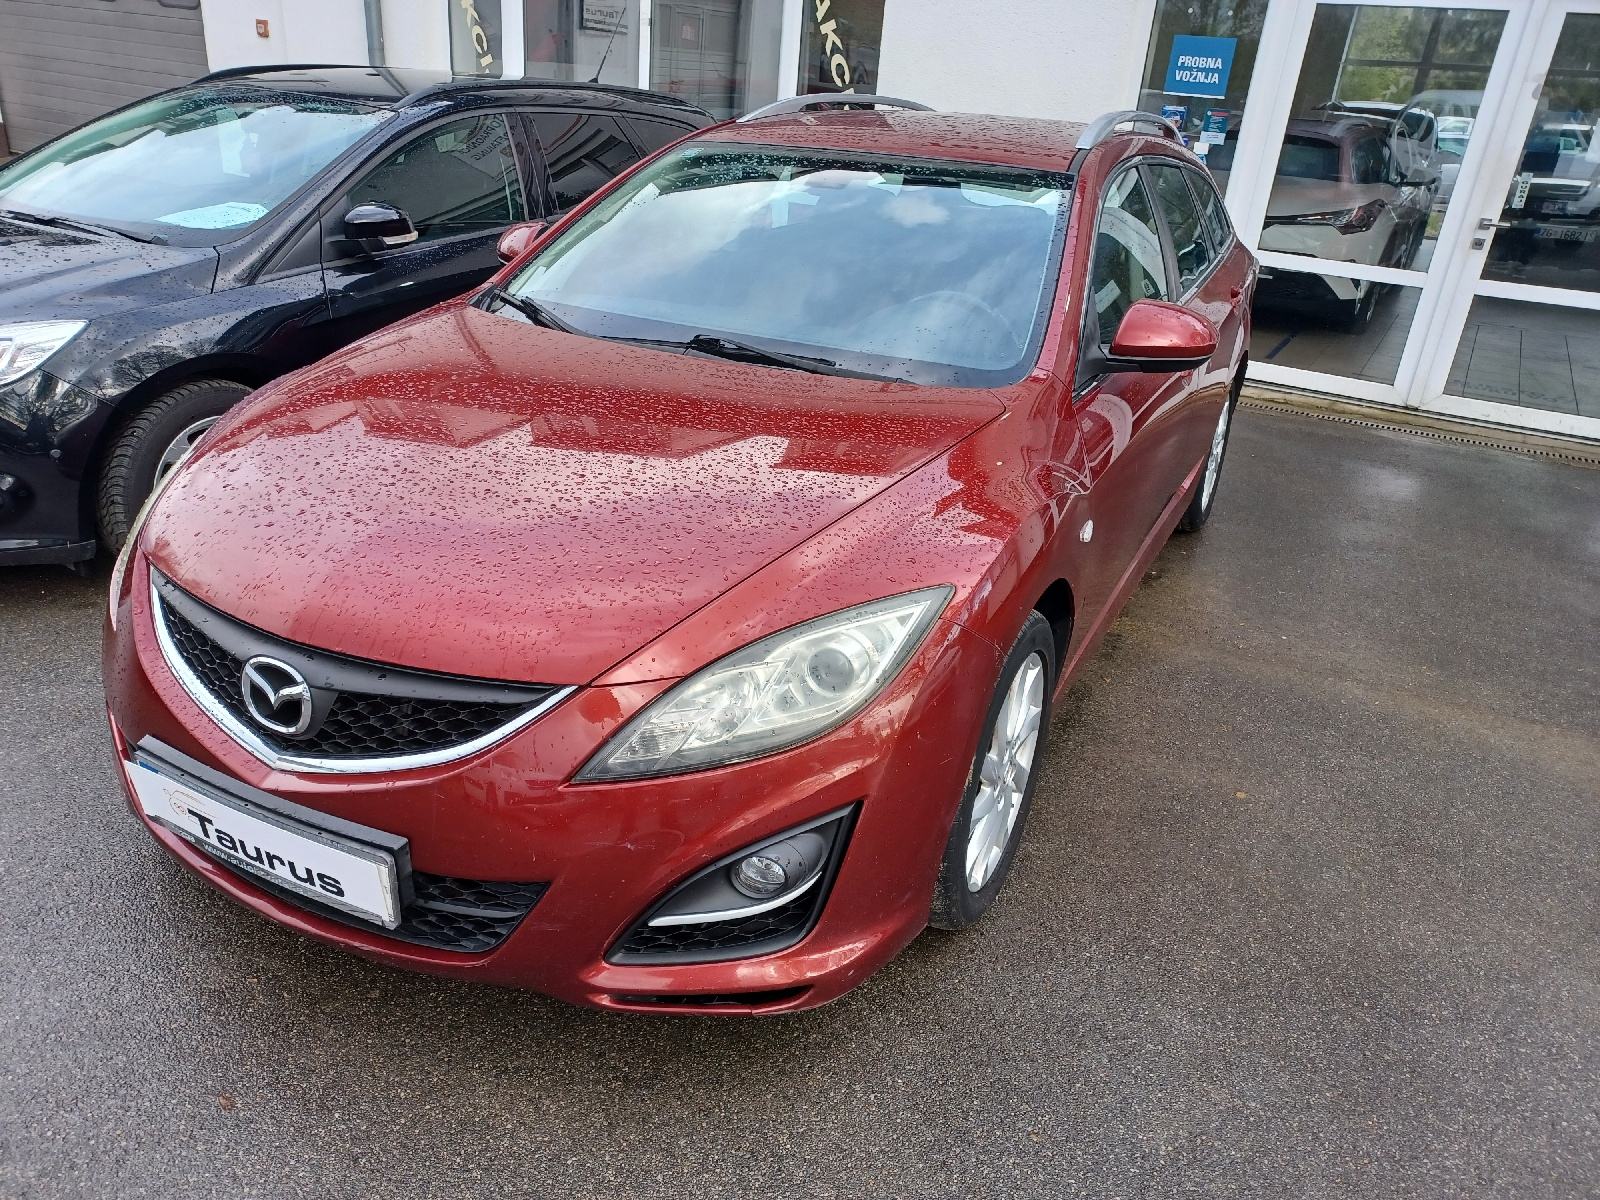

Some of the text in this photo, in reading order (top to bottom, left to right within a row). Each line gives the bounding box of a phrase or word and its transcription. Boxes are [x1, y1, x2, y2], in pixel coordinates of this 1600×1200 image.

[1177, 55, 1223, 69] PROBNA
[1175, 68, 1219, 84] VOŽNJA
[187, 807, 346, 899] Taurus
